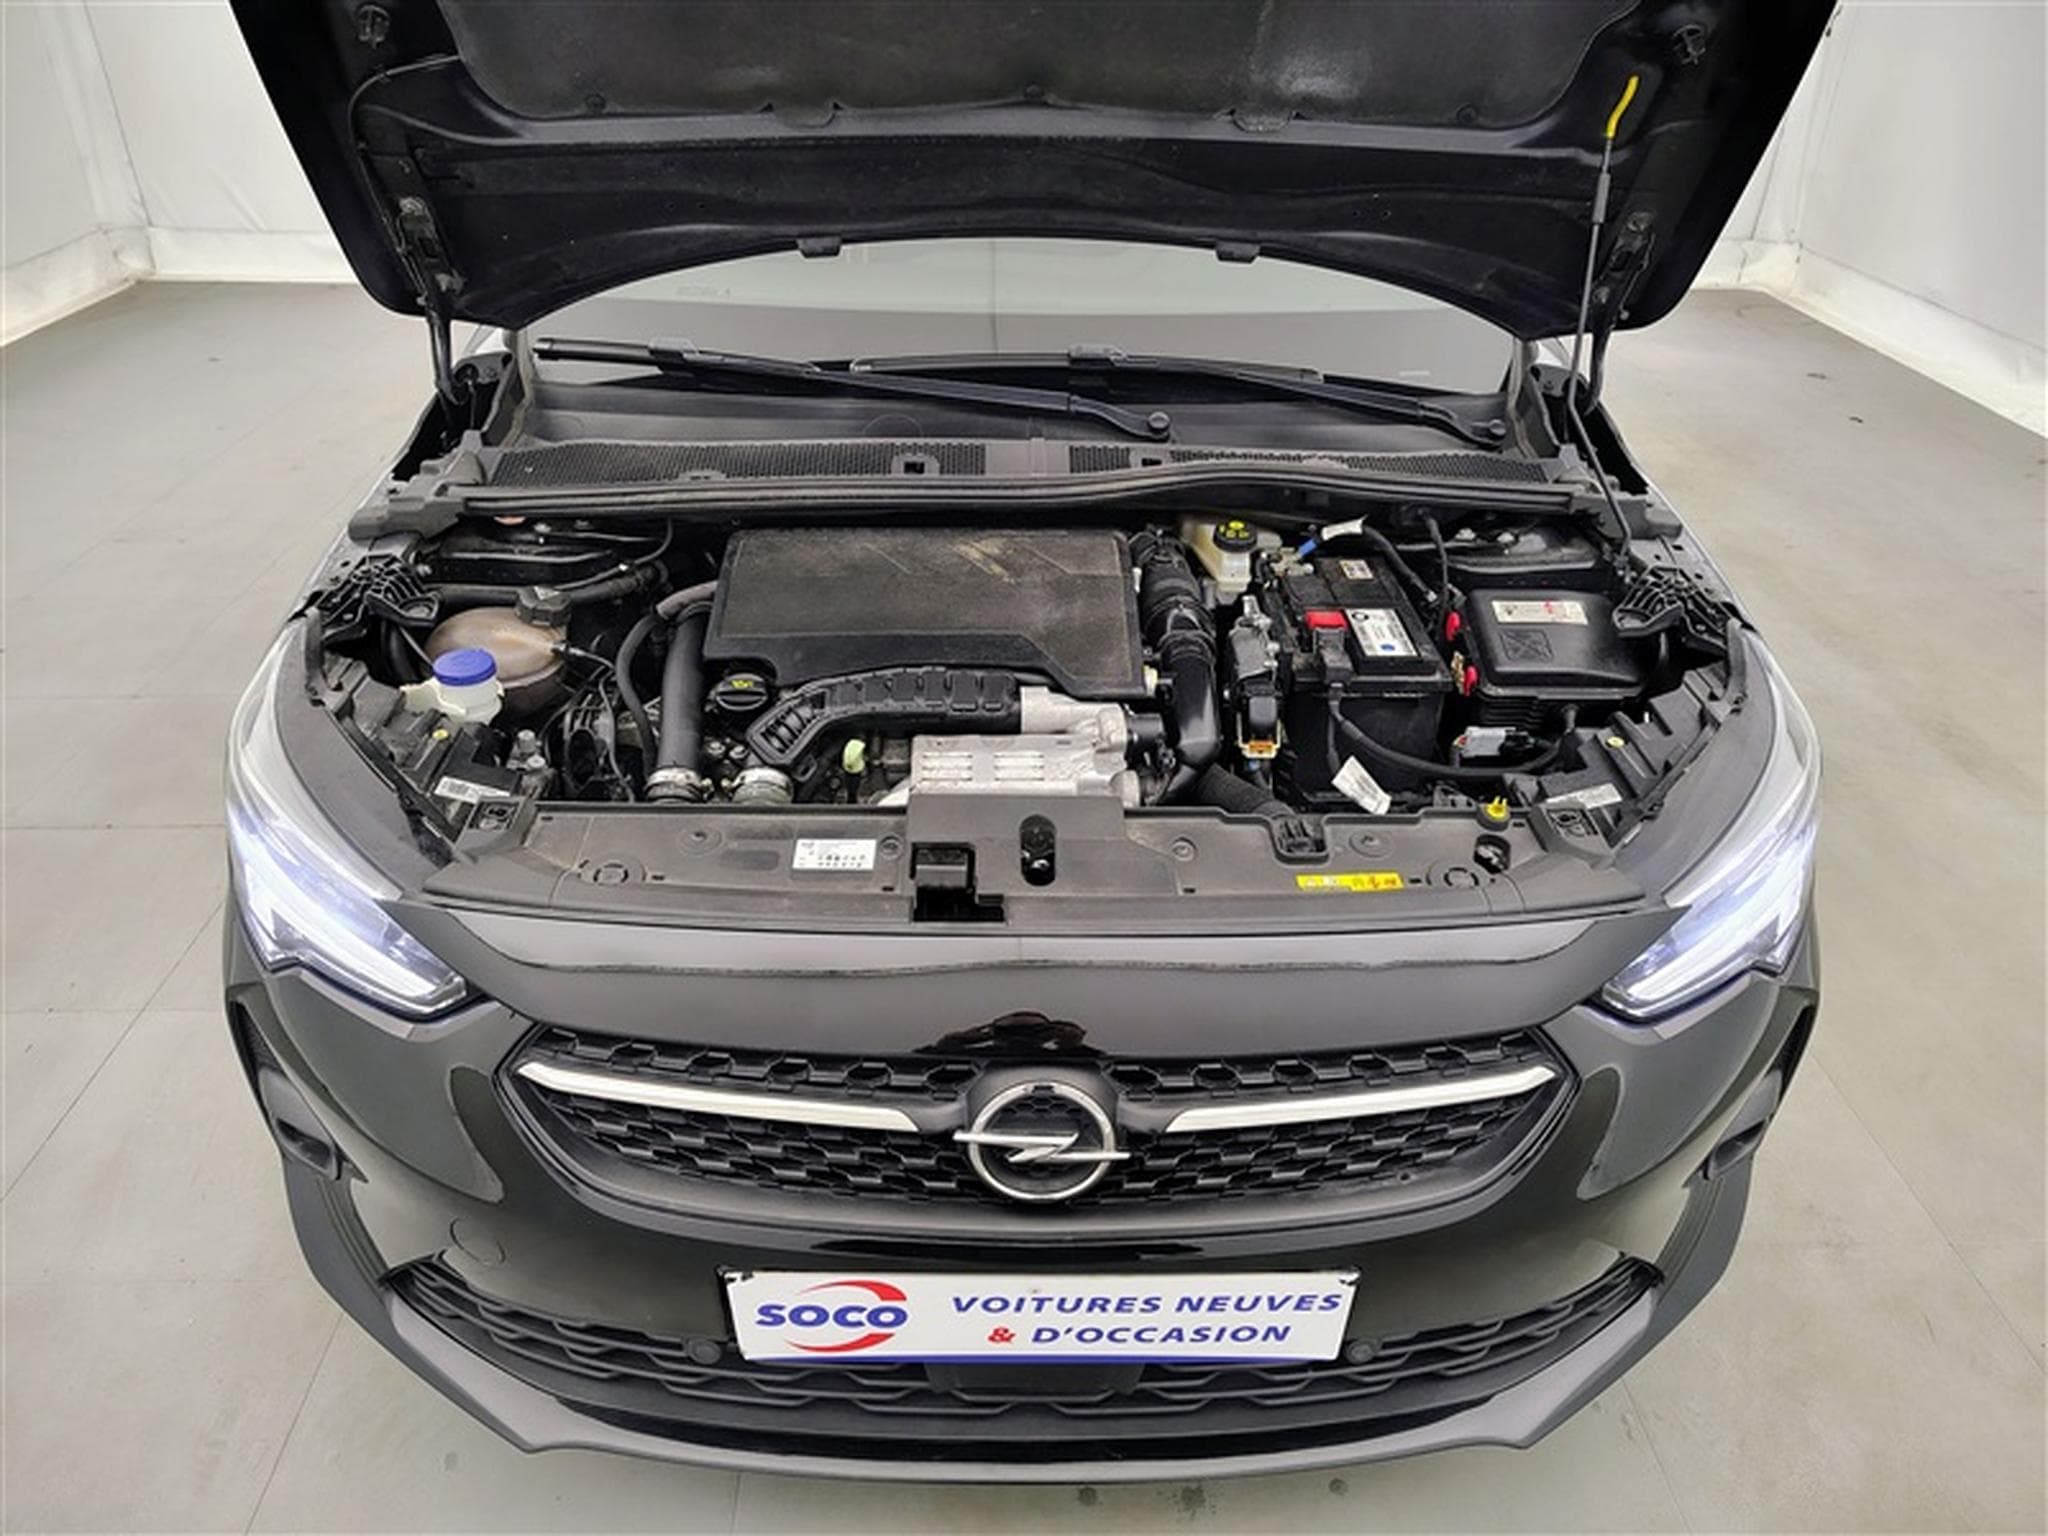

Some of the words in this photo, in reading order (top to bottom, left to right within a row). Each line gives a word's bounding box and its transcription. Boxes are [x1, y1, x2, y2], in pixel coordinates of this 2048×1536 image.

[953, 1296, 1162, 1314] VOITURES
[1175, 1294, 1343, 1313] NEUVES
[755, 1303, 909, 1329] SOCO
[987, 1326, 1017, 1344] &
[1032, 1325, 1292, 1344] D'OCCASION
